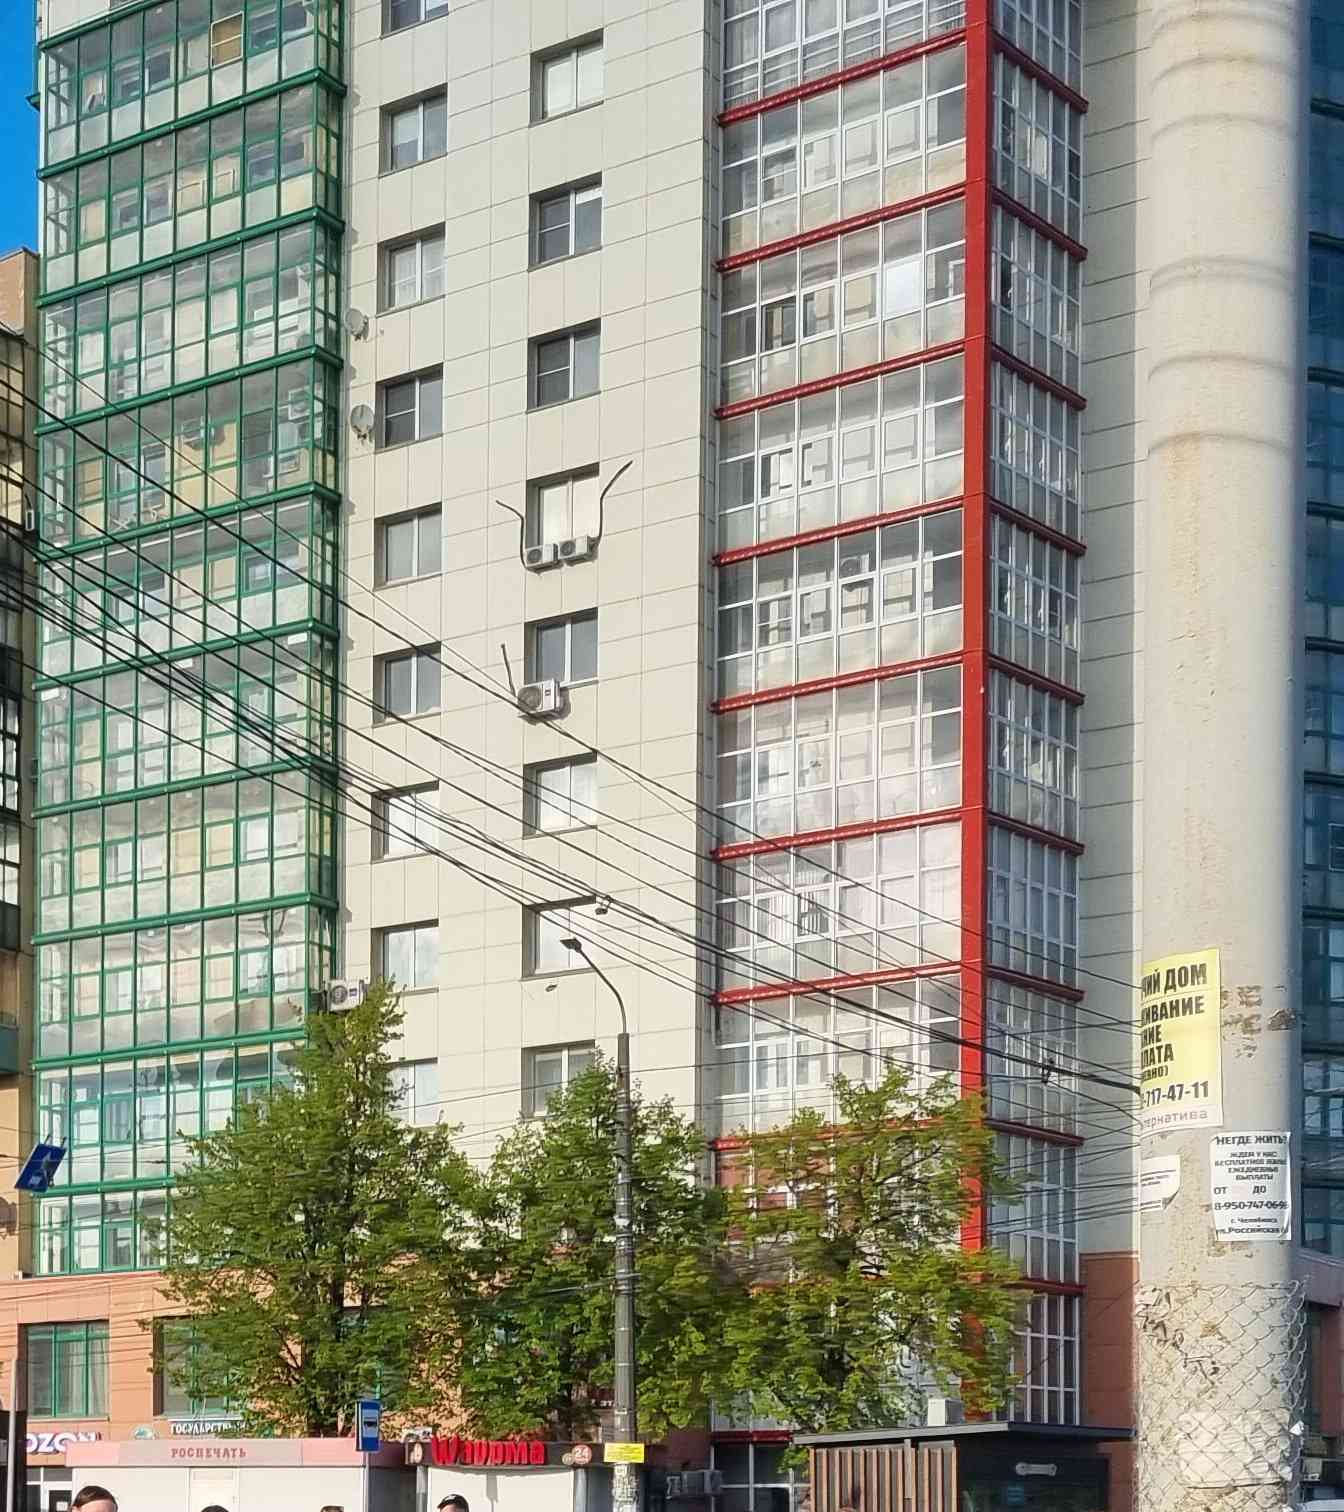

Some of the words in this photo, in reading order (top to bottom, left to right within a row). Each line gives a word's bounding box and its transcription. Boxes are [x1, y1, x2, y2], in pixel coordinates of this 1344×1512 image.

[1164, 963, 1207, 994] ДОМ
[1141, 1081, 1209, 1109] -717-47-11
[1216, 1136, 1252, 1145] НЕГДЕ
[1214, 1187, 1227, 1195] ОТ
[1253, 1185, 1267, 1194] ДО
[171, 1447, 247, 1458] РОСПЕЧАТЬ
